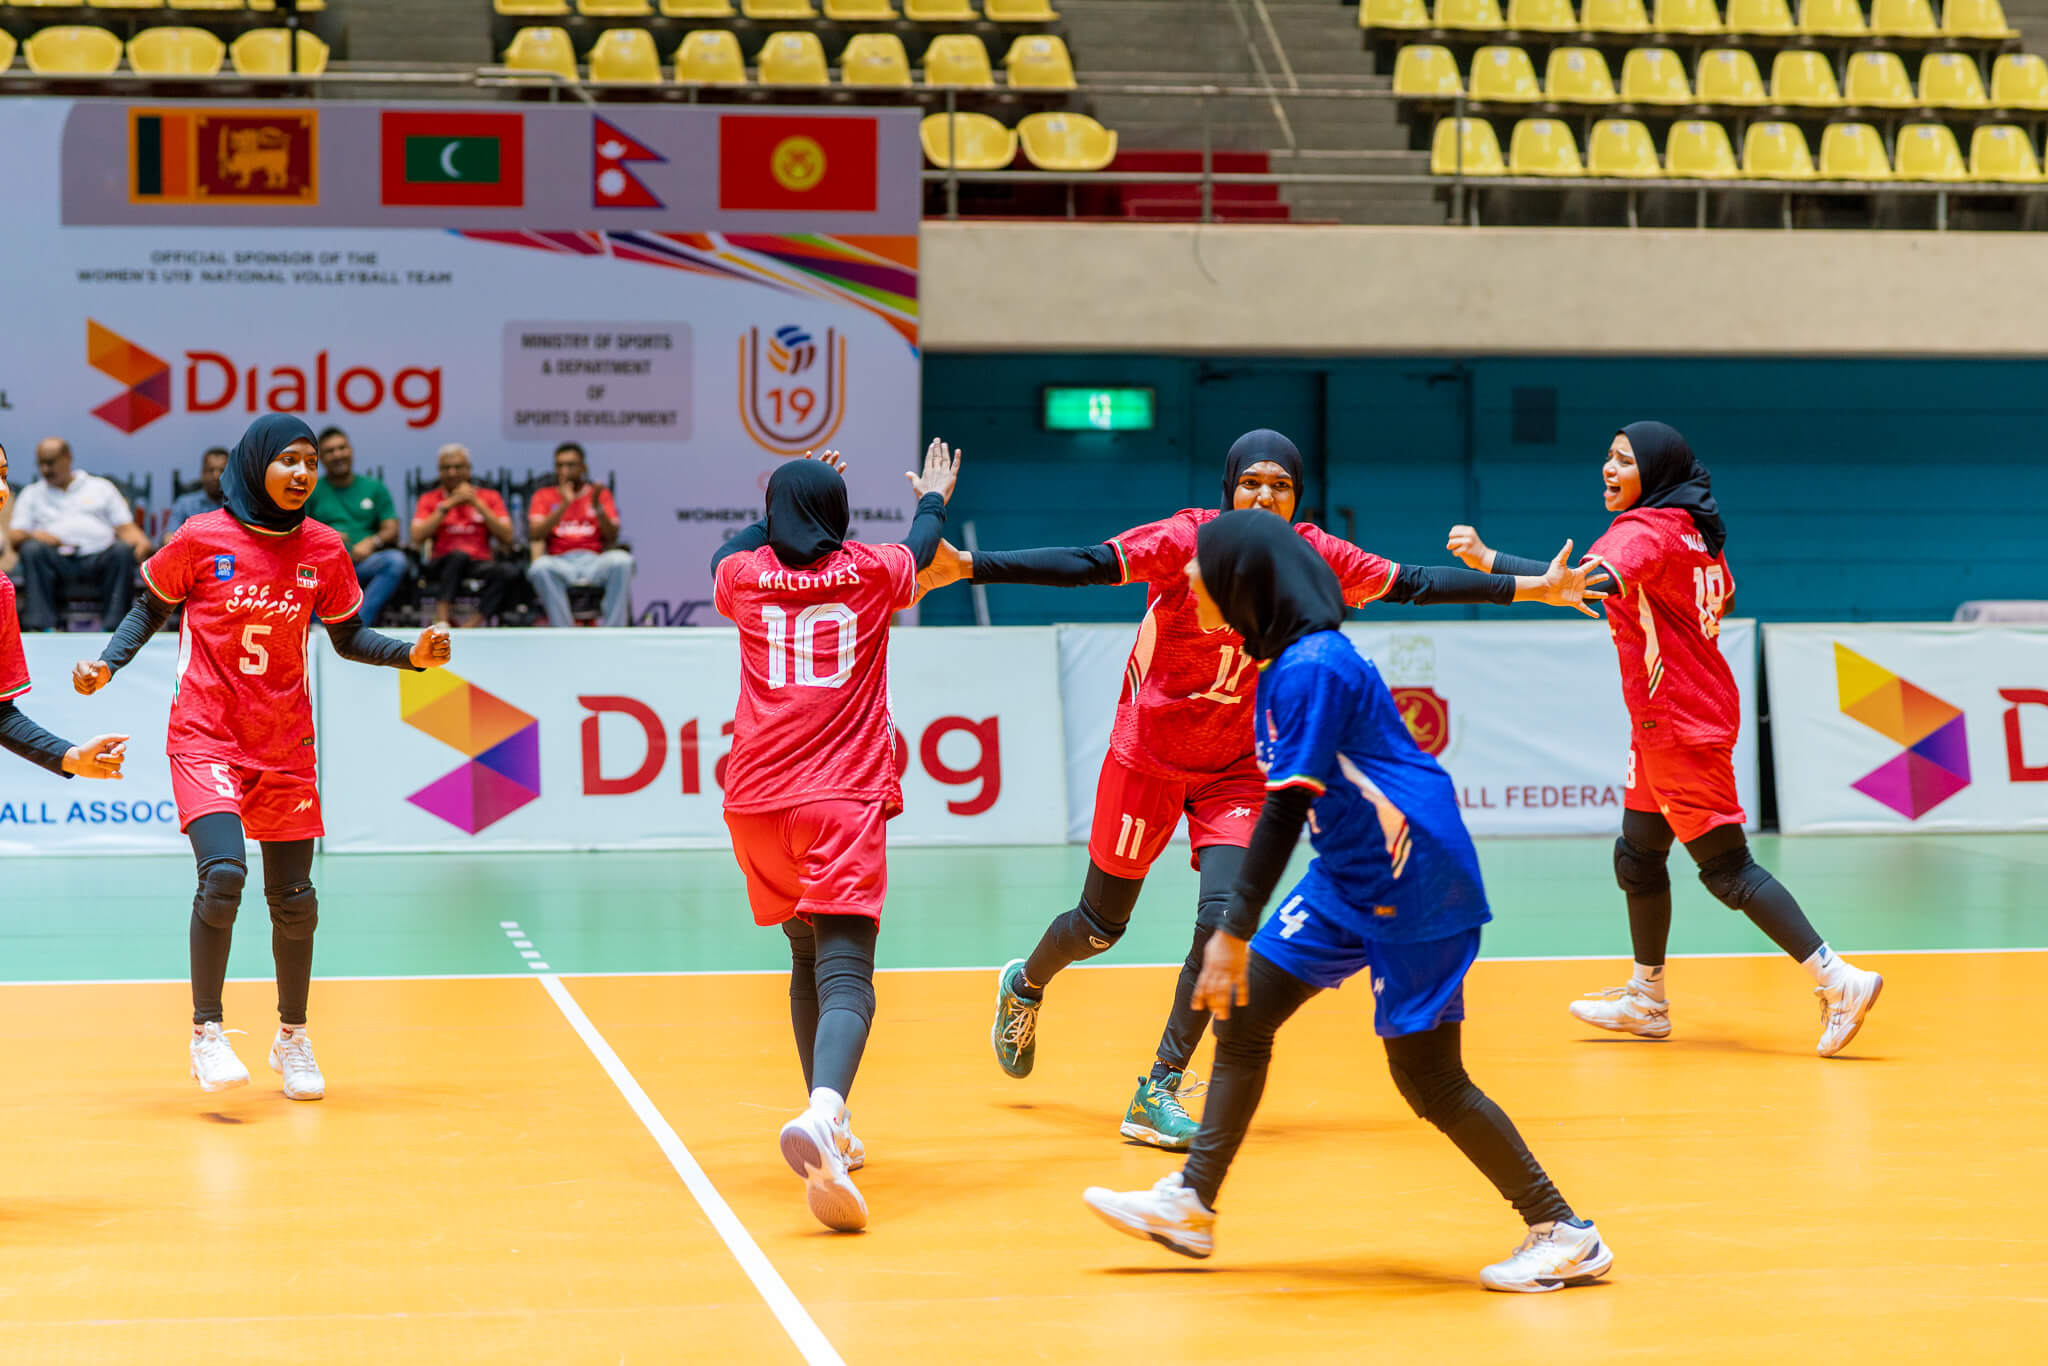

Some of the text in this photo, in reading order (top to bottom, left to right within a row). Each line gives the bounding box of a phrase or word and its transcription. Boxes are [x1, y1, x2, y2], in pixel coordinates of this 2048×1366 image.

[151, 251, 378, 265] OFFICIAL SPONSOR OF THE
[77, 269, 156, 283] WOMEN'S
[201, 269, 285, 284] NATIONAL
[292, 270, 399, 285] VOLLEYBALL
[406, 270, 453, 285] TEAM
[520, 333, 673, 349] MINISTRY OF SPORTS
[556, 360, 652, 375] DEPARTMENT
[184, 349, 442, 430] Dialog
[586, 384, 605, 401] OF
[514, 410, 678, 426] SPORTS DEVELOPMENT
[766, 386, 816, 425] 19
[676, 507, 758, 521] WOMEN'S
[758, 563, 860, 591] MALDIVES
[1693, 565, 1725, 640] 18
[239, 624, 272, 676] 5
[761, 602, 858, 690] 10
[210, 762, 236, 798] 5
[1454, 787, 1497, 809] LL
[0, 802, 56, 824] ALL
[1115, 813, 1146, 860] 11
[1279, 894, 1310, 939] 4
